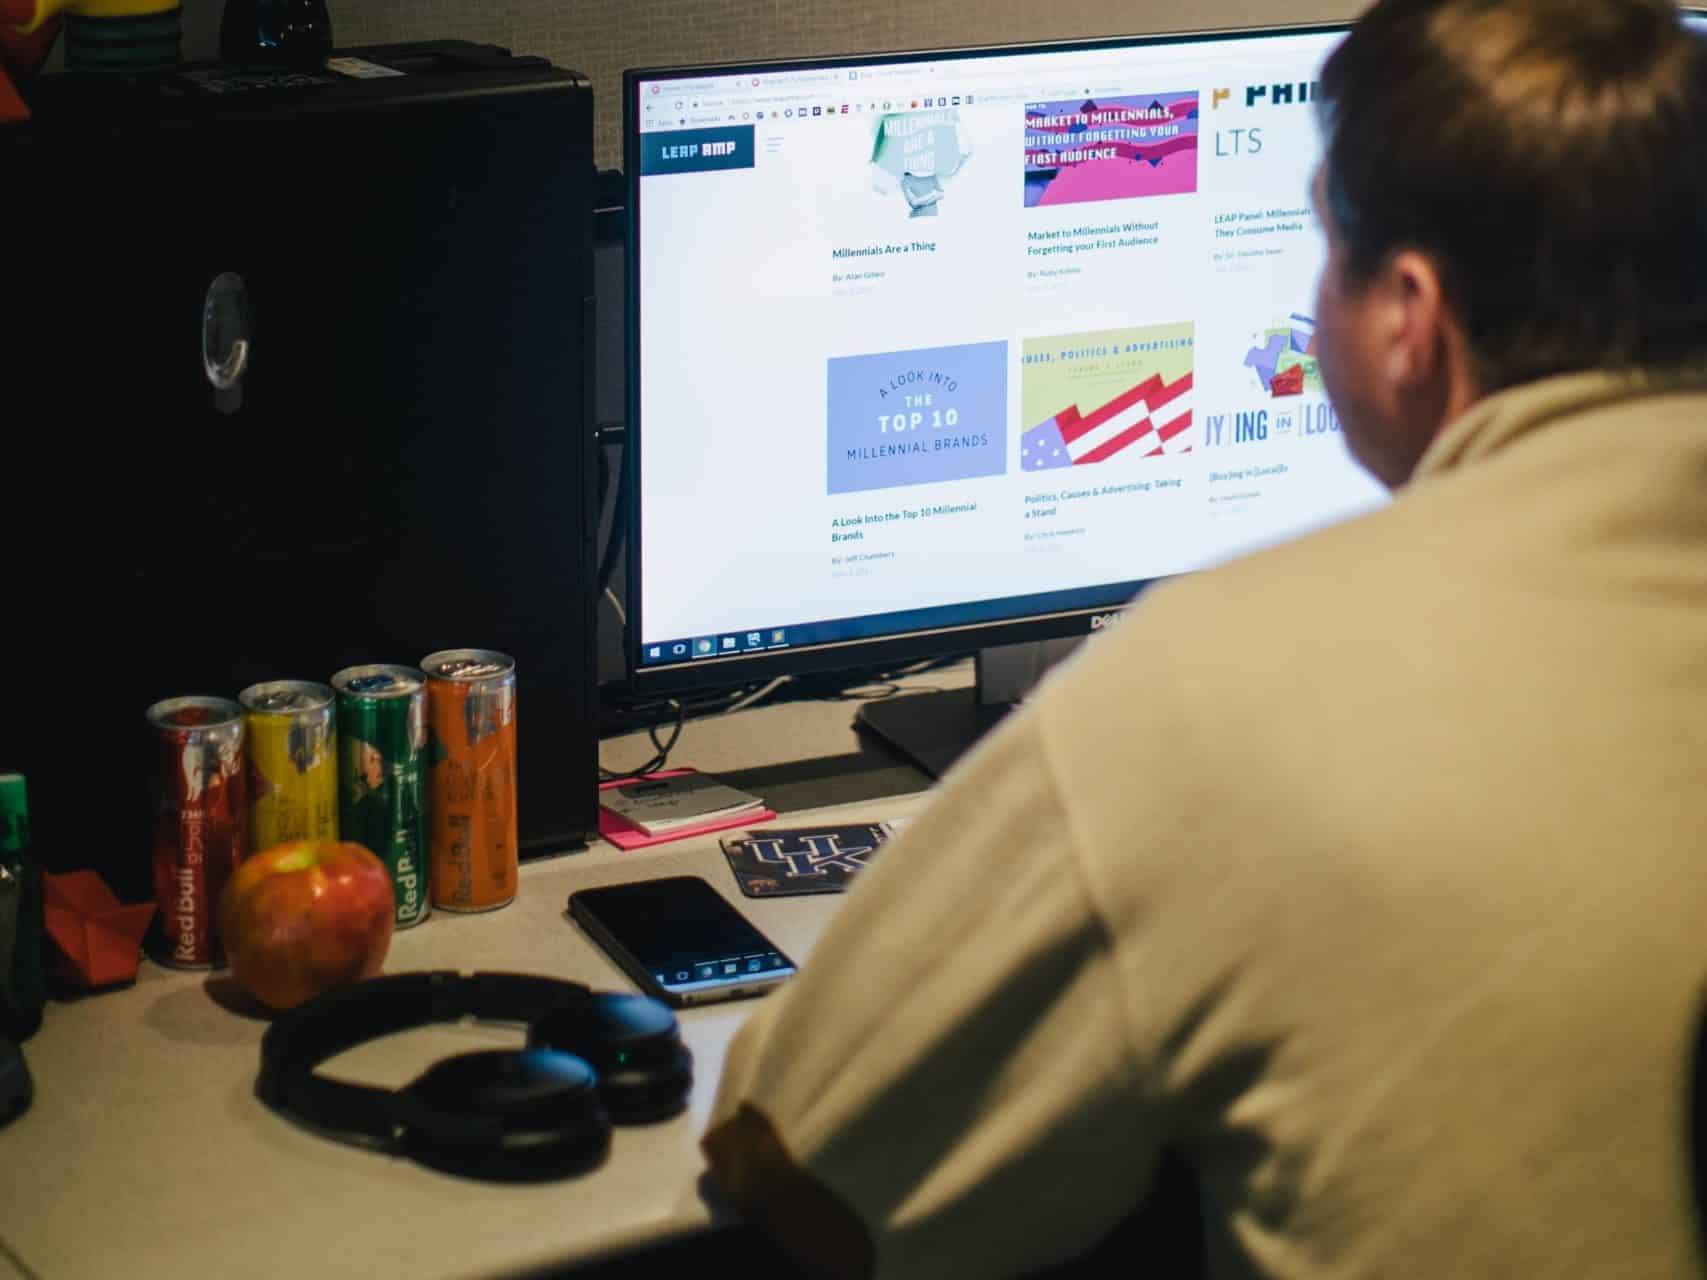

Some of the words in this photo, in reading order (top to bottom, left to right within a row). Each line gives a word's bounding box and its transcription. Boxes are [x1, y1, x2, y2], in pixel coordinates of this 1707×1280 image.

[1025, 115, 1072, 128] MARKET
[1075, 113, 1088, 124] TO
[1091, 107, 1174, 124] MILLENNIALS,
[1025, 132, 1076, 146] WITHOUT
[1079, 127, 1146, 143] FORGETTING
[1151, 125, 1179, 137] YOUR
[1216, 128, 1262, 156] LTS
[662, 144, 698, 160] LEAP
[702, 140, 736, 157] AMP
[1025, 151, 1057, 164] FIRST
[1060, 147, 1117, 162] AUDIENCE
[1215, 212, 1237, 225] LEAP
[1027, 228, 1060, 241] Market
[1062, 228, 1072, 238] to
[1073, 223, 1121, 237] Millennials
[1122, 221, 1159, 233] Without
[832, 245, 883, 258] Millennials
[885, 244, 902, 254] Are
[911, 241, 936, 252] Thing
[1027, 242, 1073, 256] Forgetting
[1075, 242, 1094, 254] your
[1096, 239, 1116, 249] First
[1118, 235, 1158, 247] Audience
[1061, 345, 1107, 360] POLITICS
[1125, 337, 1193, 352] ADVERTISING
[879, 388, 888, 400] A
[890, 369, 925, 390] LOOK
[928, 371, 958, 393] INTO
[905, 394, 933, 409] THE
[878, 412, 923, 434] TOP
[932, 408, 959, 428] 10
[1276, 415, 1292, 429] IN
[847, 441, 928, 461] MILLENNIAL
[934, 433, 989, 451] BRANDS
[1060, 489, 1091, 501] Causes
[832, 518, 840, 527] A
[841, 515, 863, 527] Look
[865, 512, 883, 523] Into
[884, 510, 900, 521] the
[902, 508, 918, 520] Top
[920, 507, 931, 518] 10
[933, 502, 977, 517] Millennial
[1031, 507, 1057, 519] Stand
[831, 530, 863, 543] Brands
[397, 874, 417, 921] Red
[176, 915, 195, 961] Red
